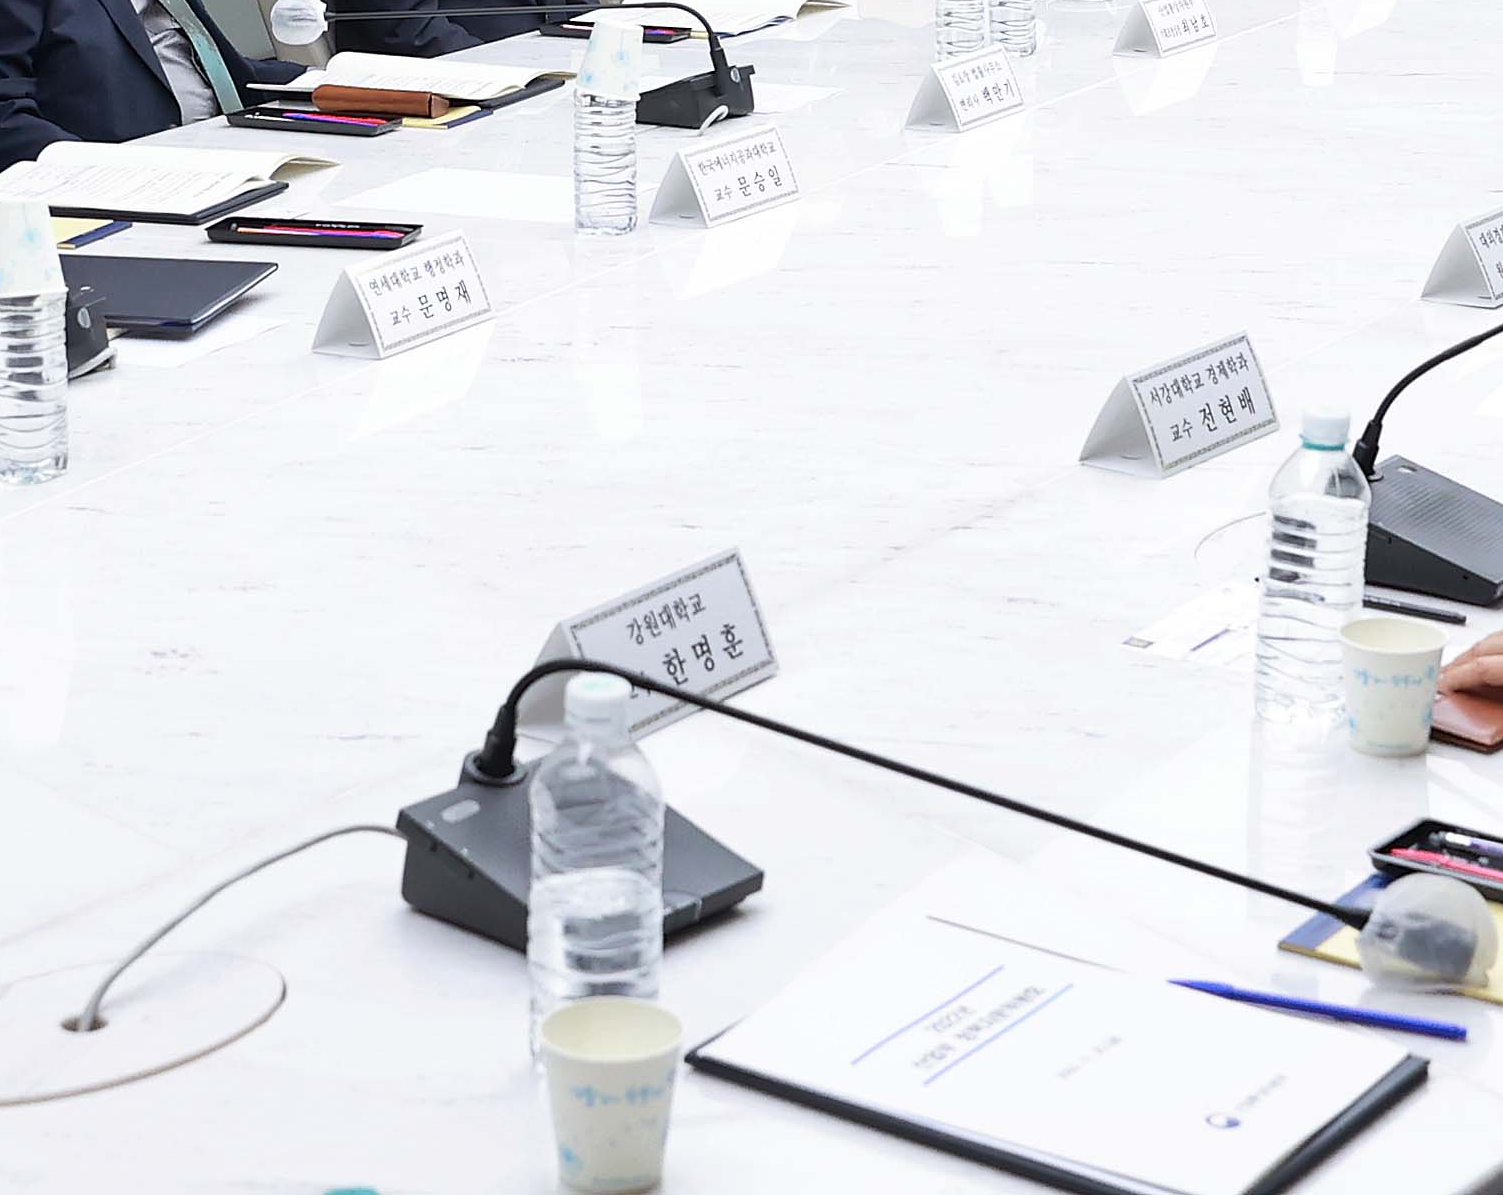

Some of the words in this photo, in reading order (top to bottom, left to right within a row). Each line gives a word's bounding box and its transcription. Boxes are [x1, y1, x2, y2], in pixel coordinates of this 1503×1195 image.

[699, 142, 777, 175] 한국에너지공과대학교
[714, 185, 733, 201] 교수
[369, 267, 422, 297] 연세대학교
[424, 252, 466, 277] 행정학과
[390, 305, 413, 326] 교수
[1150, 373, 1204, 406] 서강대학교
[1206, 353, 1250, 385] 경제학과
[1170, 418, 1193, 442] 교수
[627, 594, 707, 646] 강원대학교
